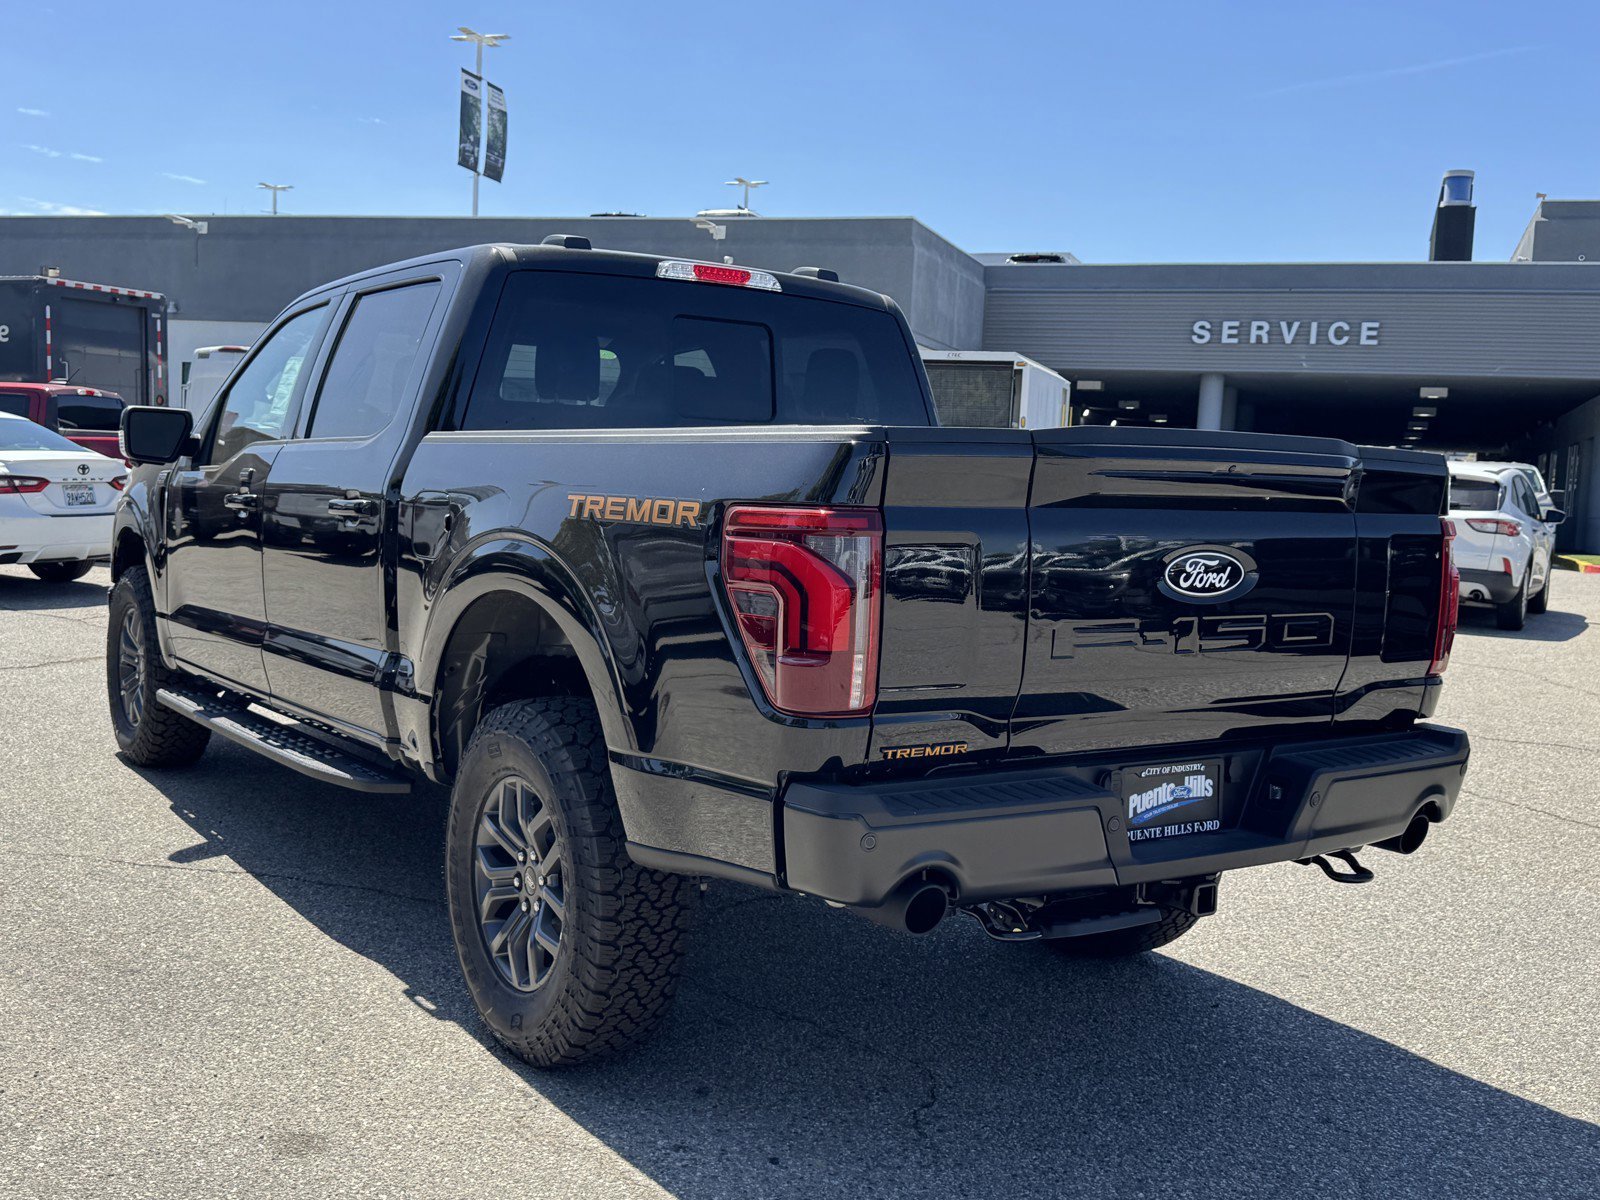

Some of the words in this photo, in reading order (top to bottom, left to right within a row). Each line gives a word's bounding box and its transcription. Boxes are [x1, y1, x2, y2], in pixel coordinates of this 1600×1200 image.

[1191, 320, 1380, 345] SERVICE
[567, 494, 700, 527] TREMOR
[1180, 557, 1230, 588] Ford
[1051, 613, 1334, 659] F-150
[883, 744, 968, 759] TREMOR
[1145, 767, 1162, 775] CITY
[1161, 766, 1171, 774] OF
[1171, 763, 1202, 773] INDUSTRY
[1128, 782, 1176, 818] Puente
[1184, 775, 1213, 798] Hills
[1164, 823, 1192, 837] HILLS
